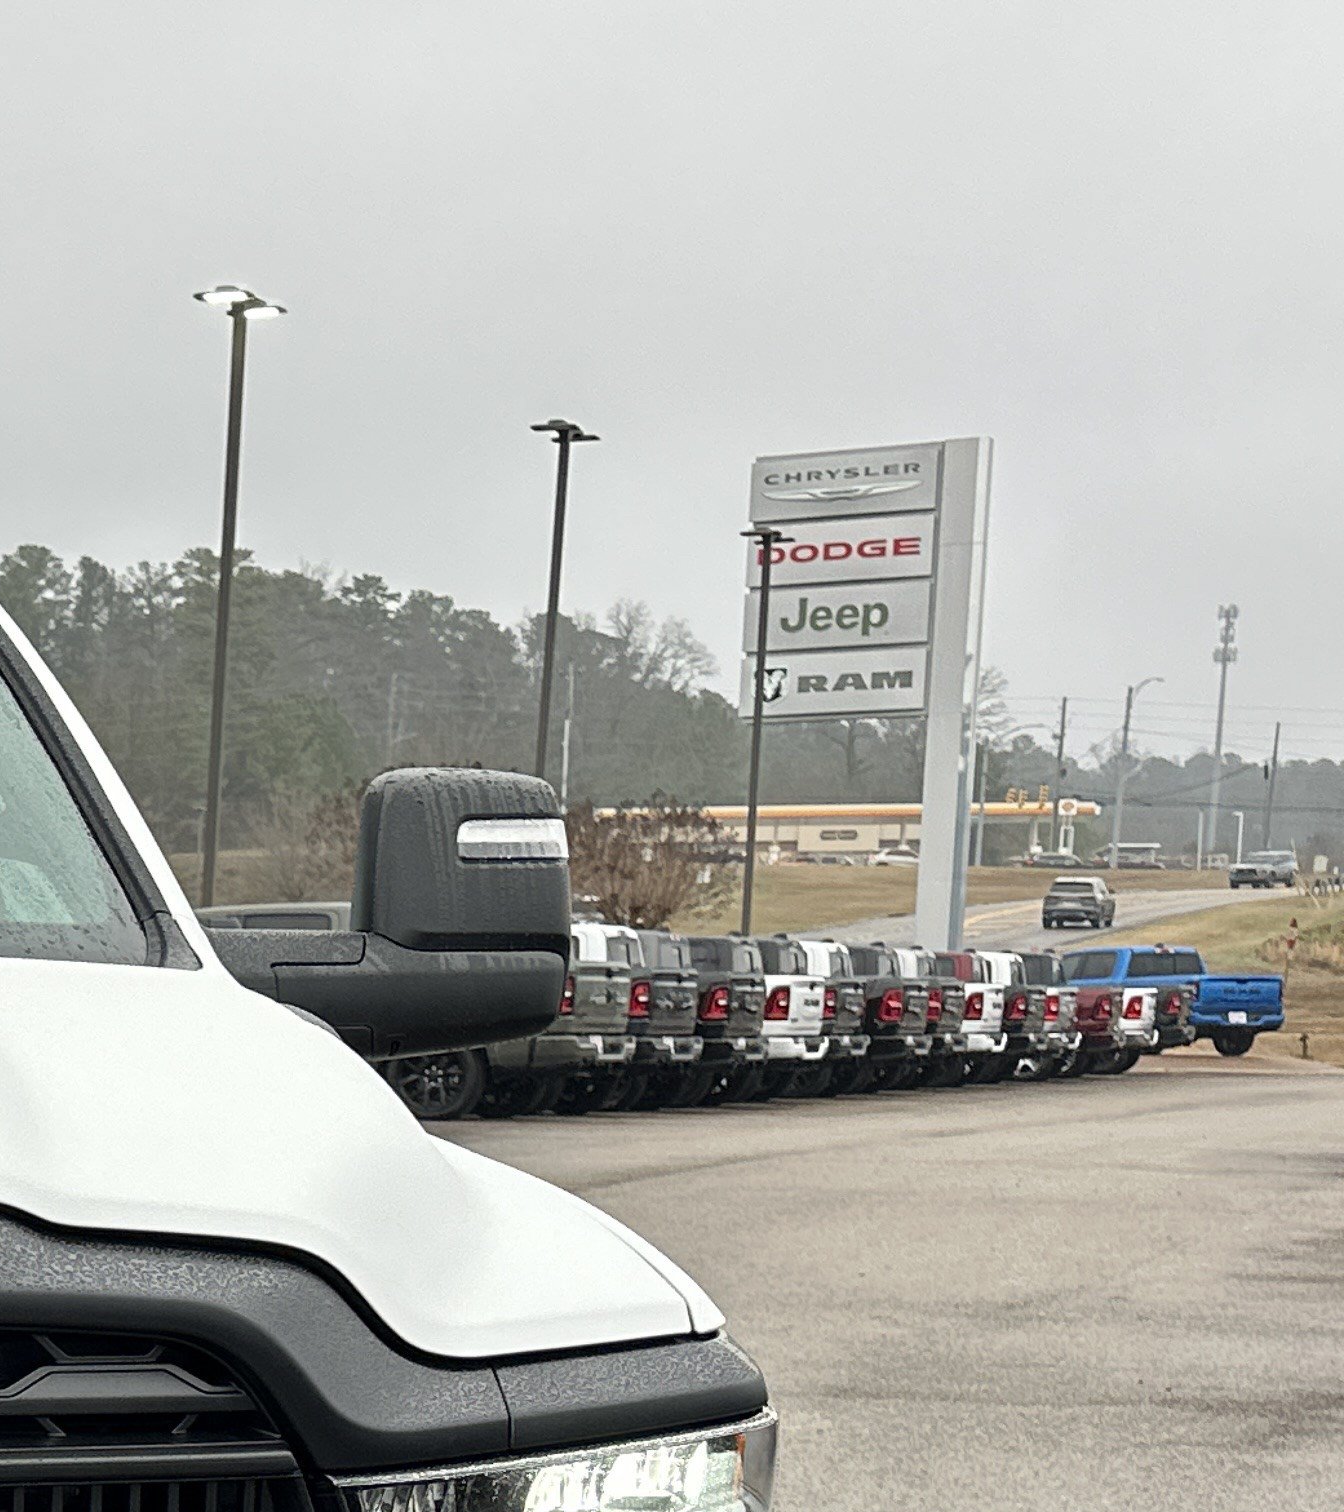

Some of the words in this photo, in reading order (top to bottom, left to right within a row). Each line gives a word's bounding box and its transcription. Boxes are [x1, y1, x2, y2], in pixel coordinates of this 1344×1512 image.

[763, 461, 921, 486] CHRYSLER
[756, 536, 922, 566] DODGE
[780, 598, 889, 635] Jeep
[797, 670, 913, 693] RAM
